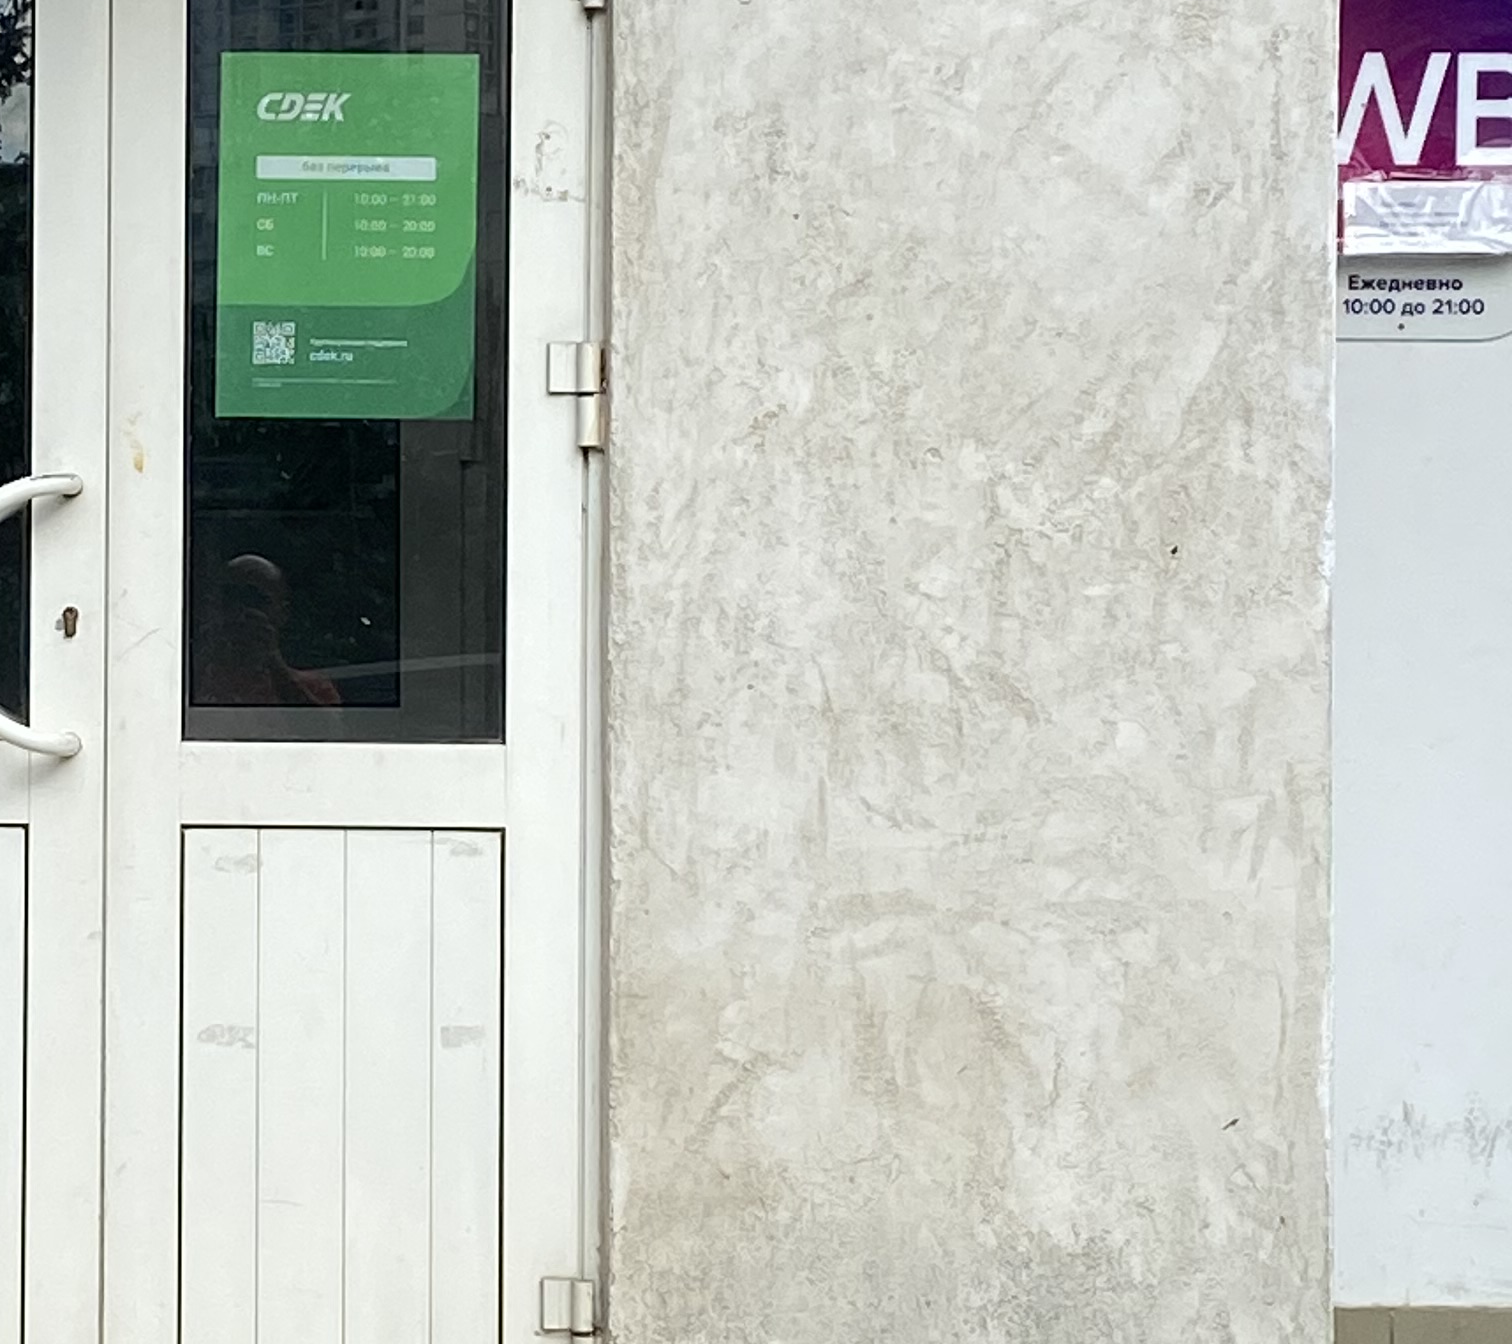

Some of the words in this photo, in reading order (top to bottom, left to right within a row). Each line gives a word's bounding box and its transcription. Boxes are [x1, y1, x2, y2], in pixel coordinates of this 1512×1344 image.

[256, 91, 352, 123] CDEK
[1338, 52, 1512, 166] WB
[256, 192, 299, 205] ПН-ПТ
[1347, 274, 1464, 293] Ежедневно
[1342, 298, 1396, 316] 10:00
[1400, 301, 1426, 317] до
[1432, 298, 1485, 316] 21:00
[309, 349, 354, 362] cdek.ru
